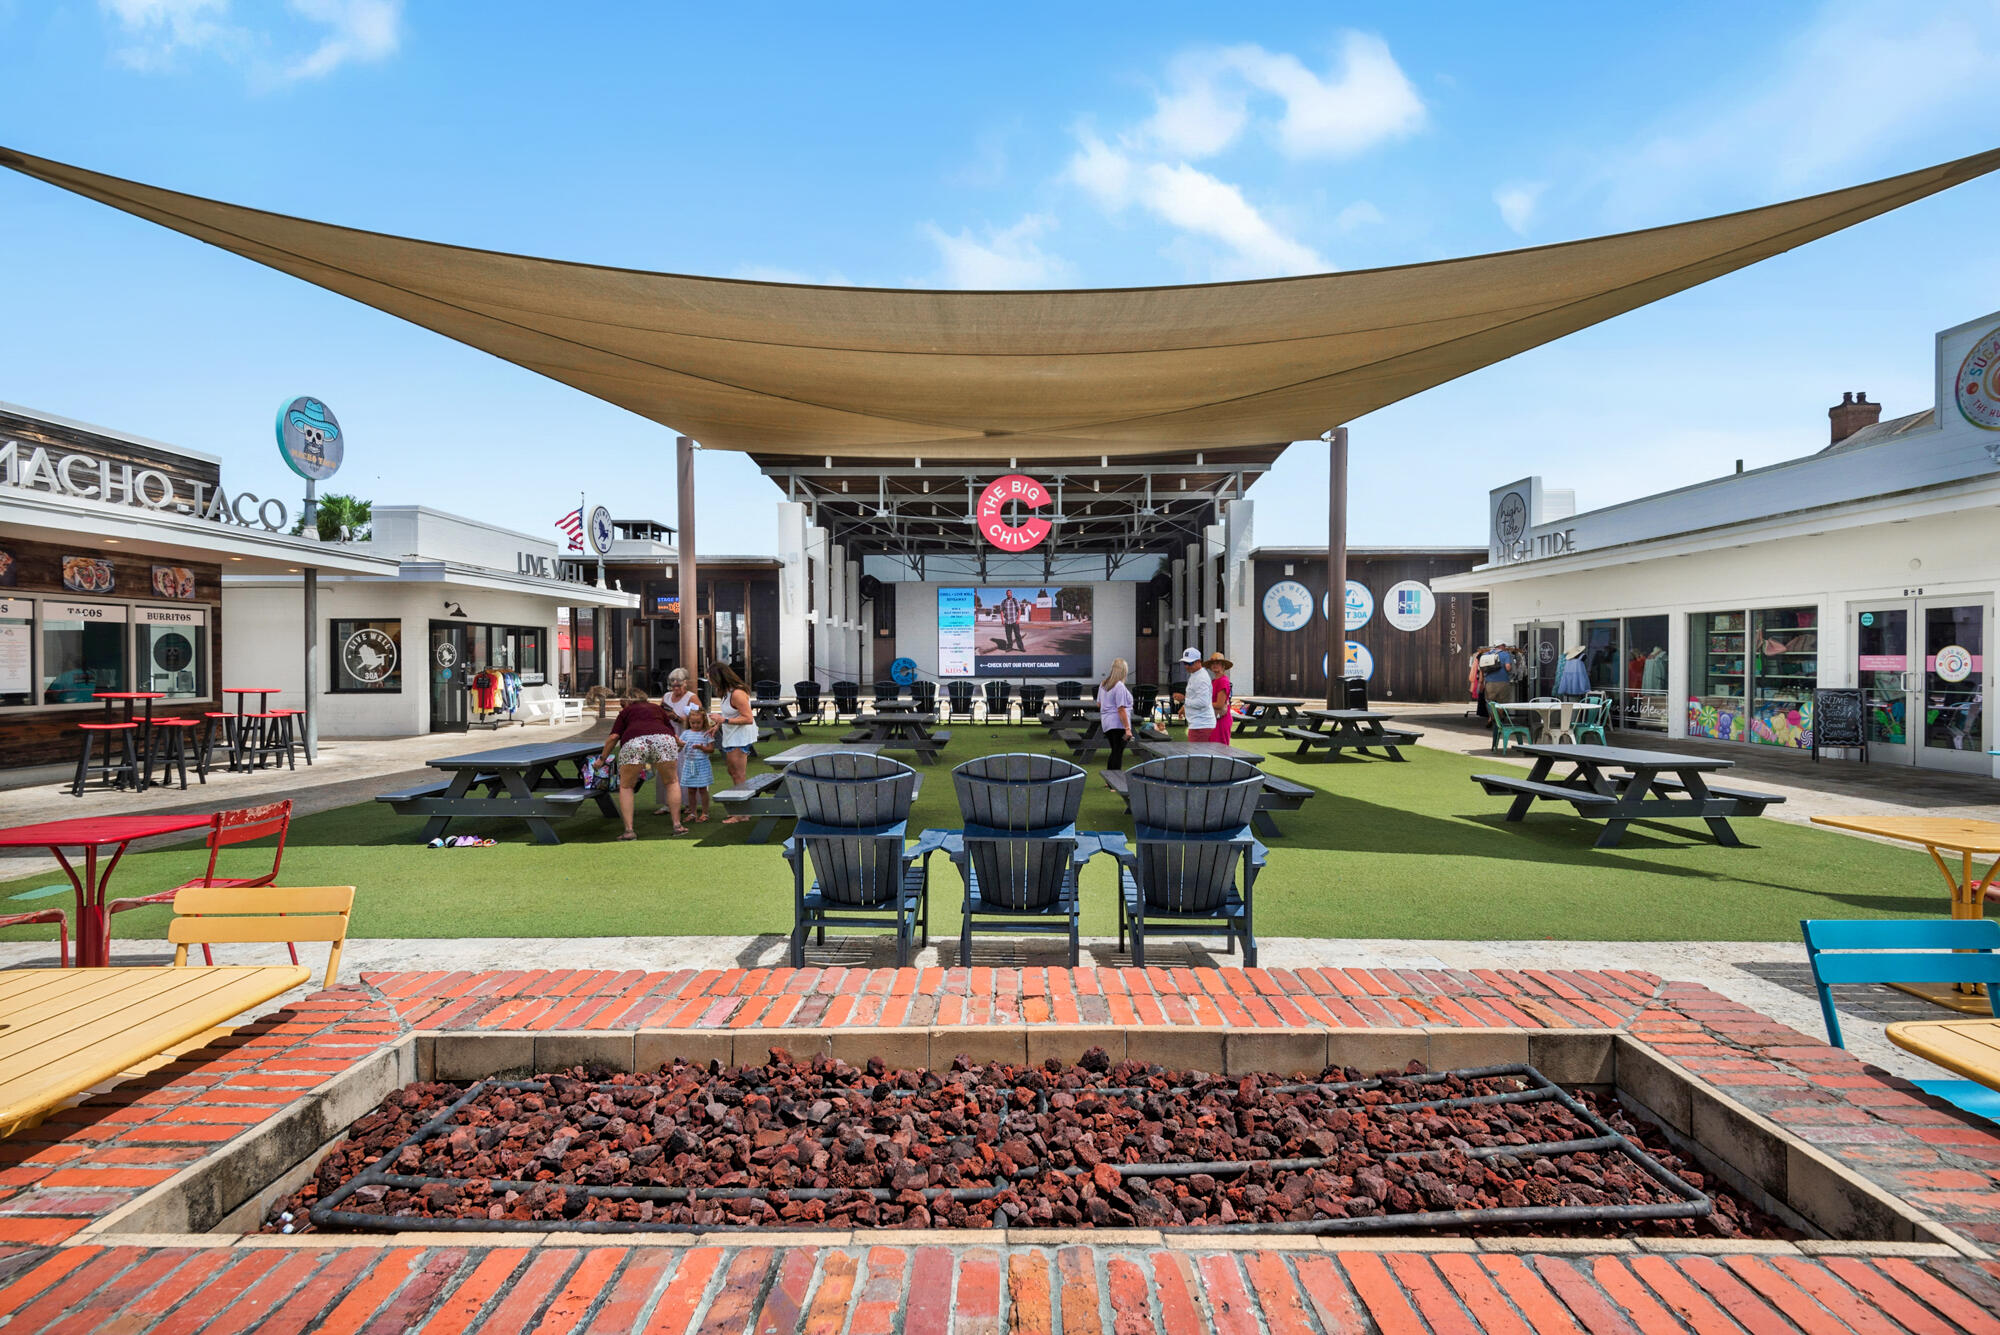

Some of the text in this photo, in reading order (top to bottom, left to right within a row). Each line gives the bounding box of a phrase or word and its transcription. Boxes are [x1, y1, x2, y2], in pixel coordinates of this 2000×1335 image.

[1973, 399, 1987, 414] THE
[184, 478, 288, 532] TACO
[983, 480, 1040, 517] THE BIG
[989, 524, 1041, 545] CHILL
[1496, 528, 1576, 563] HIGH TIDE
[517, 551, 588, 585] LIVE WELL
[1268, 584, 1309, 600] LIVE WELL
[67, 607, 103, 618] TACOS
[147, 612, 192, 622] BURRITOS
[1449, 596, 1457, 655] RESTROOMS
[348, 632, 391, 651] LIVE WELL
[364, 672, 379, 680] 30A
[1822, 695, 1849, 705] SLIME
